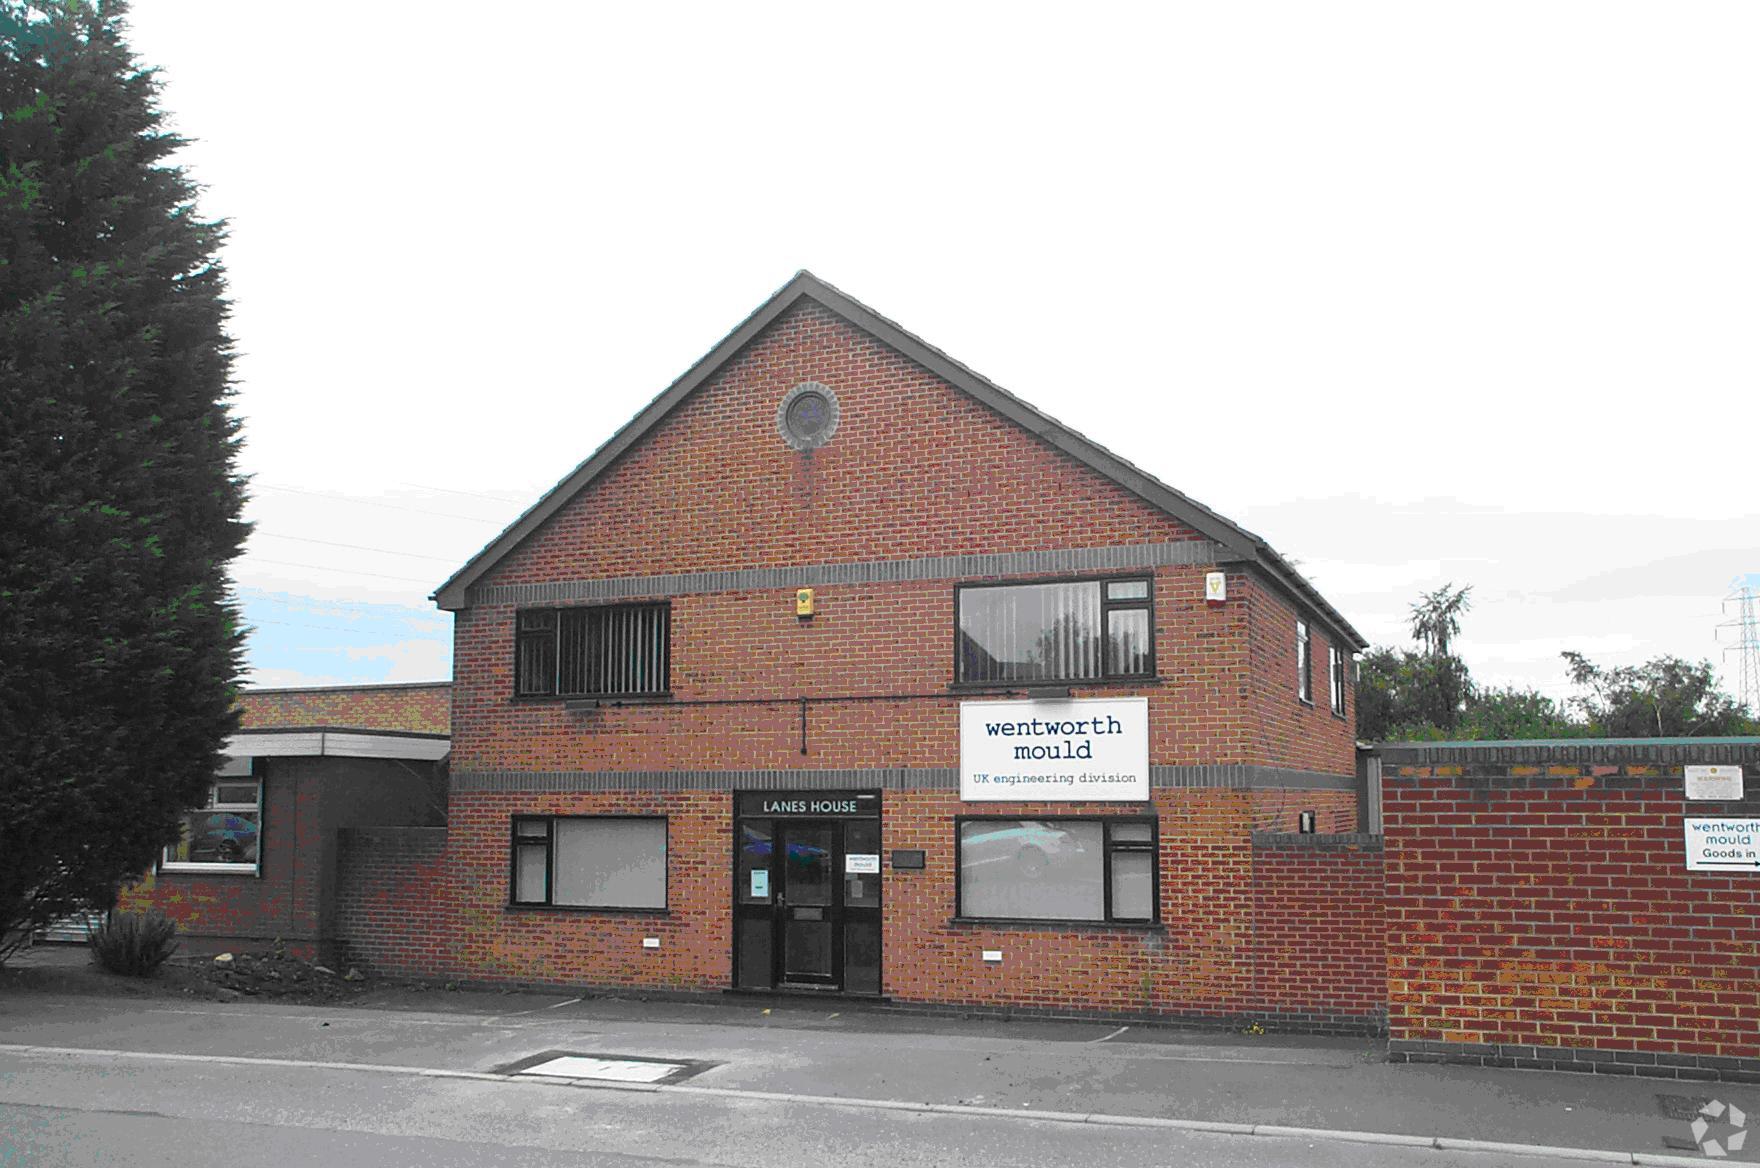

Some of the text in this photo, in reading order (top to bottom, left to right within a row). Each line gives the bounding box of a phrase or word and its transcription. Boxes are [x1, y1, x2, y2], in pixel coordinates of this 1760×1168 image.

[985, 715, 1123, 737] wentworth
[1013, 740, 1093, 760] mould
[973, 772, 1137, 786] UK engineering division
[763, 800, 857, 813] LANES HOUSE
[1705, 834, 1752, 845] mould
[1702, 848, 1756, 858] Goods in
